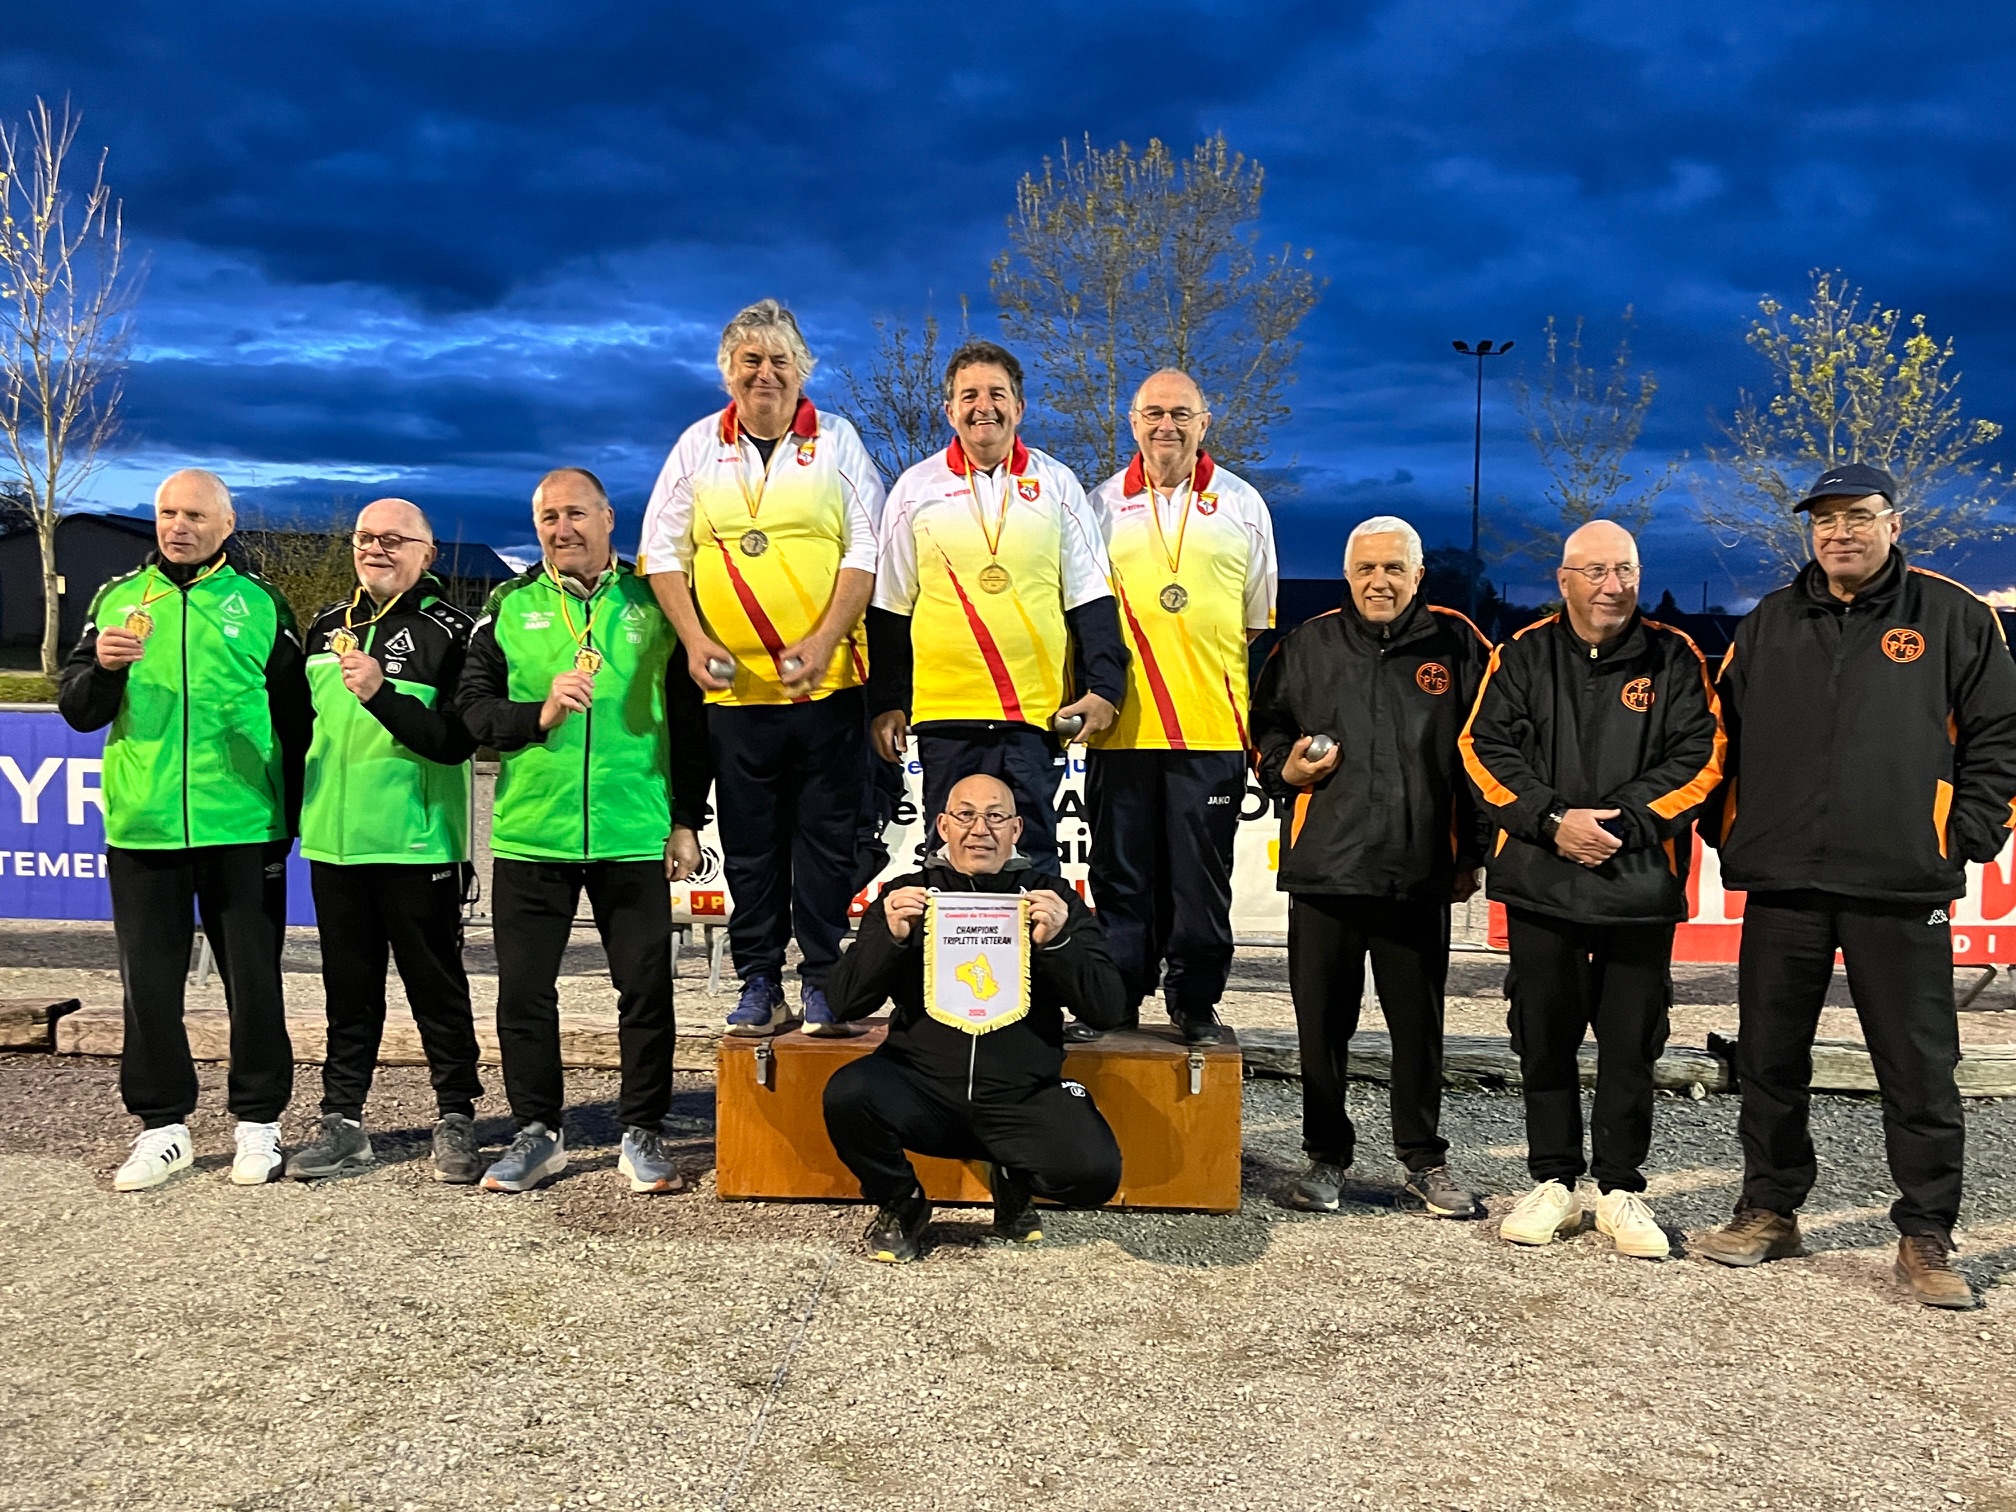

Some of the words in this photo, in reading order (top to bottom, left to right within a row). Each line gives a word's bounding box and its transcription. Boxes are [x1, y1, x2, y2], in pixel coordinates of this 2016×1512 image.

[1207, 796, 1231, 806] JAKO
[956, 926, 998, 934] CHAMPIONS
[943, 936, 978, 944] TRIPLETTE
[980, 936, 1011, 944] VETERAN
